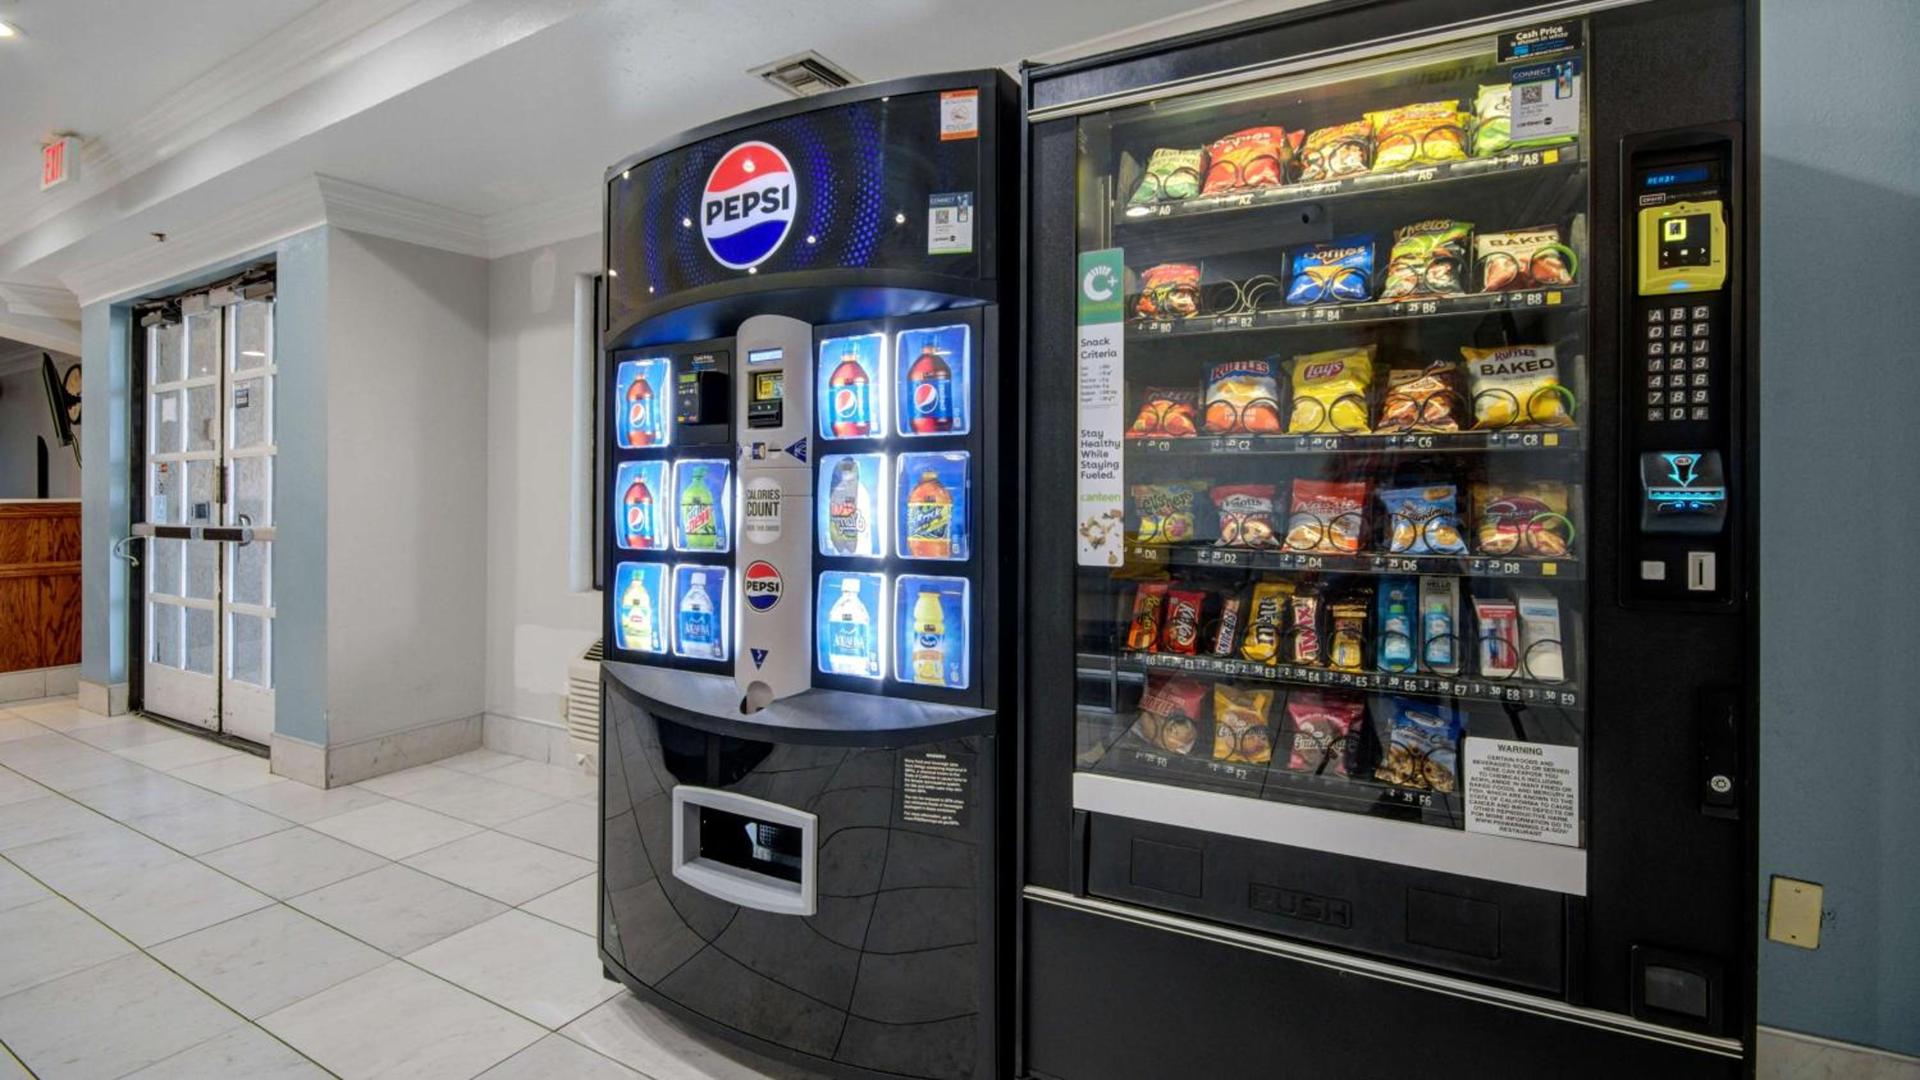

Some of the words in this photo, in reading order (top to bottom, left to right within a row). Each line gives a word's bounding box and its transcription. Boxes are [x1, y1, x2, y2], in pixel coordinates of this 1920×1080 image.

[1516, 31, 1538, 41] Cash
[1540, 26, 1563, 36] Price
[1513, 67, 1551, 79] CONNECT
[1523, 154, 1539, 166] A8
[1418, 171, 1433, 182] A6
[706, 184, 790, 226] PEPSI
[1239, 194, 1251, 206] A2
[1159, 206, 1171, 216] A0
[1489, 234, 1559, 247] BAKED
[1526, 292, 1541, 305] B8
[1422, 301, 1436, 314] B6
[1327, 309, 1339, 321] B4
[1651, 310, 1661, 321] A
[1672, 308, 1684, 320] B
[1695, 307, 1706, 318] C
[1240, 316, 1252, 327] B2
[1160, 323, 1171, 333] B0
[1673, 325, 1683, 336] E
[1695, 324, 1705, 334] F
[1081, 337, 1111, 348] Snack
[1651, 343, 1662, 354] G
[1671, 342, 1684, 353] H
[1695, 341, 1705, 352] J
[1081, 348, 1117, 360] Criteria
[1480, 358, 1555, 377] BAKED
[1672, 358, 1684, 369] 2
[1695, 357, 1706, 368] 3
[1306, 361, 1342, 378] Lay's
[1651, 376, 1661, 387] 4
[1673, 375, 1684, 386] 5
[1695, 374, 1705, 385] 6
[1650, 393, 1661, 404] 7
[1673, 391, 1684, 402] 8
[1695, 390, 1706, 402] 9
[1081, 429, 1104, 439] Stay
[1522, 434, 1538, 445] C8
[1081, 439, 1121, 450] Healthy
[1158, 441, 1169, 450] C0
[1238, 440, 1250, 450] C2
[1324, 439, 1337, 449] C4
[1417, 436, 1432, 448] C6
[1081, 450, 1109, 459] While
[1081, 460, 1120, 471] Staying
[1081, 470, 1116, 480] Fueled.
[747, 489, 780, 500] CALORIES
[1081, 492, 1121, 502] canteen
[747, 501, 779, 517] COUNT
[1144, 548, 1156, 559] D0
[1224, 553, 1236, 564] D2
[1308, 557, 1321, 568] D4
[1402, 559, 1417, 570] D6
[1504, 562, 1520, 574] D8
[746, 580, 780, 592] PEPSI
[1184, 659, 1193, 669] E1
[1224, 663, 1235, 674] E2
[1265, 667, 1275, 678] E3
[1308, 672, 1319, 682] E4
[1355, 676, 1367, 687] E5
[1403, 679, 1416, 691] E6
[1454, 684, 1467, 696] E7
[1506, 688, 1520, 700] E8
[1561, 692, 1575, 705] E9
[1497, 744, 1543, 755] WARNING
[1236, 768, 1247, 779] F2
[1418, 793, 1432, 808] F6
